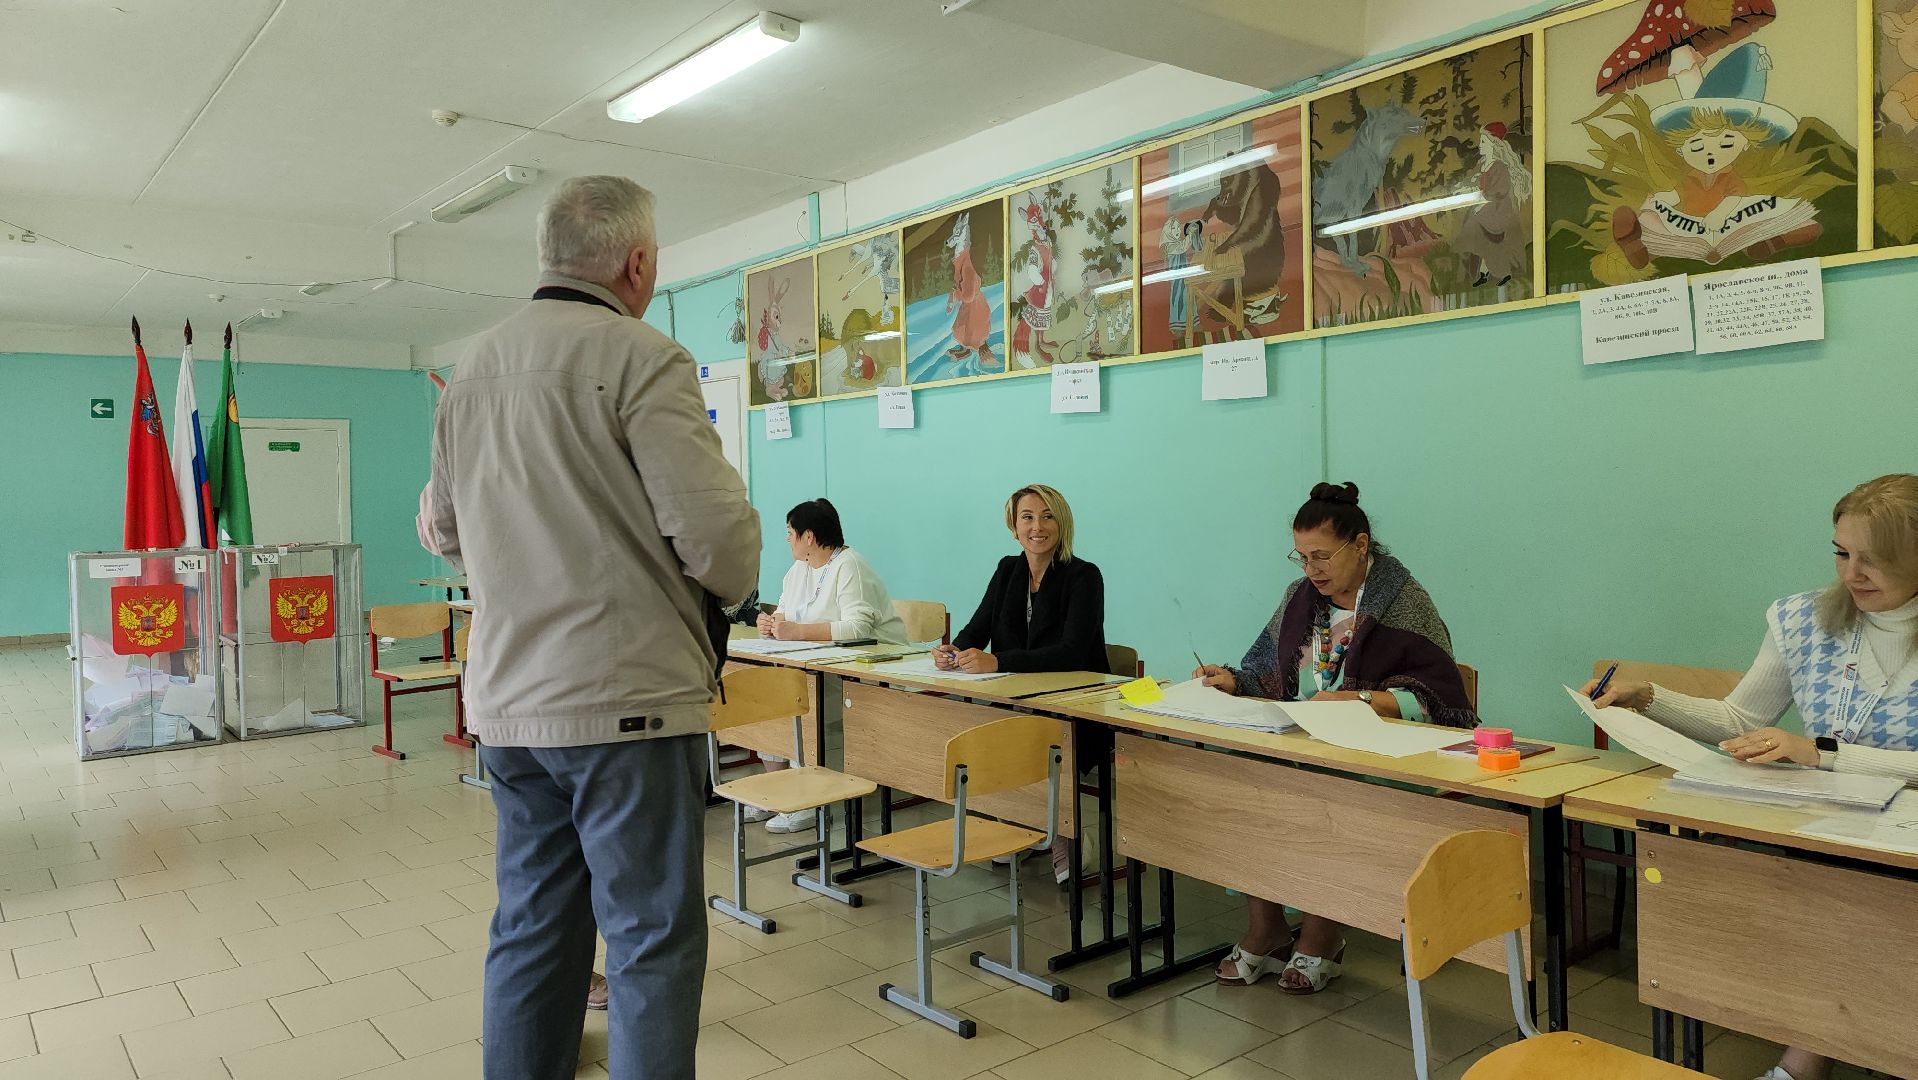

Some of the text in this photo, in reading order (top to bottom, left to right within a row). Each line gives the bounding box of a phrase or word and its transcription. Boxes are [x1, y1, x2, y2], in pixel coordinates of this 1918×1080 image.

[1703, 275, 1765, 291] Ярославское
[178, 559, 203, 571] №1
[254, 554, 275, 564] №2
